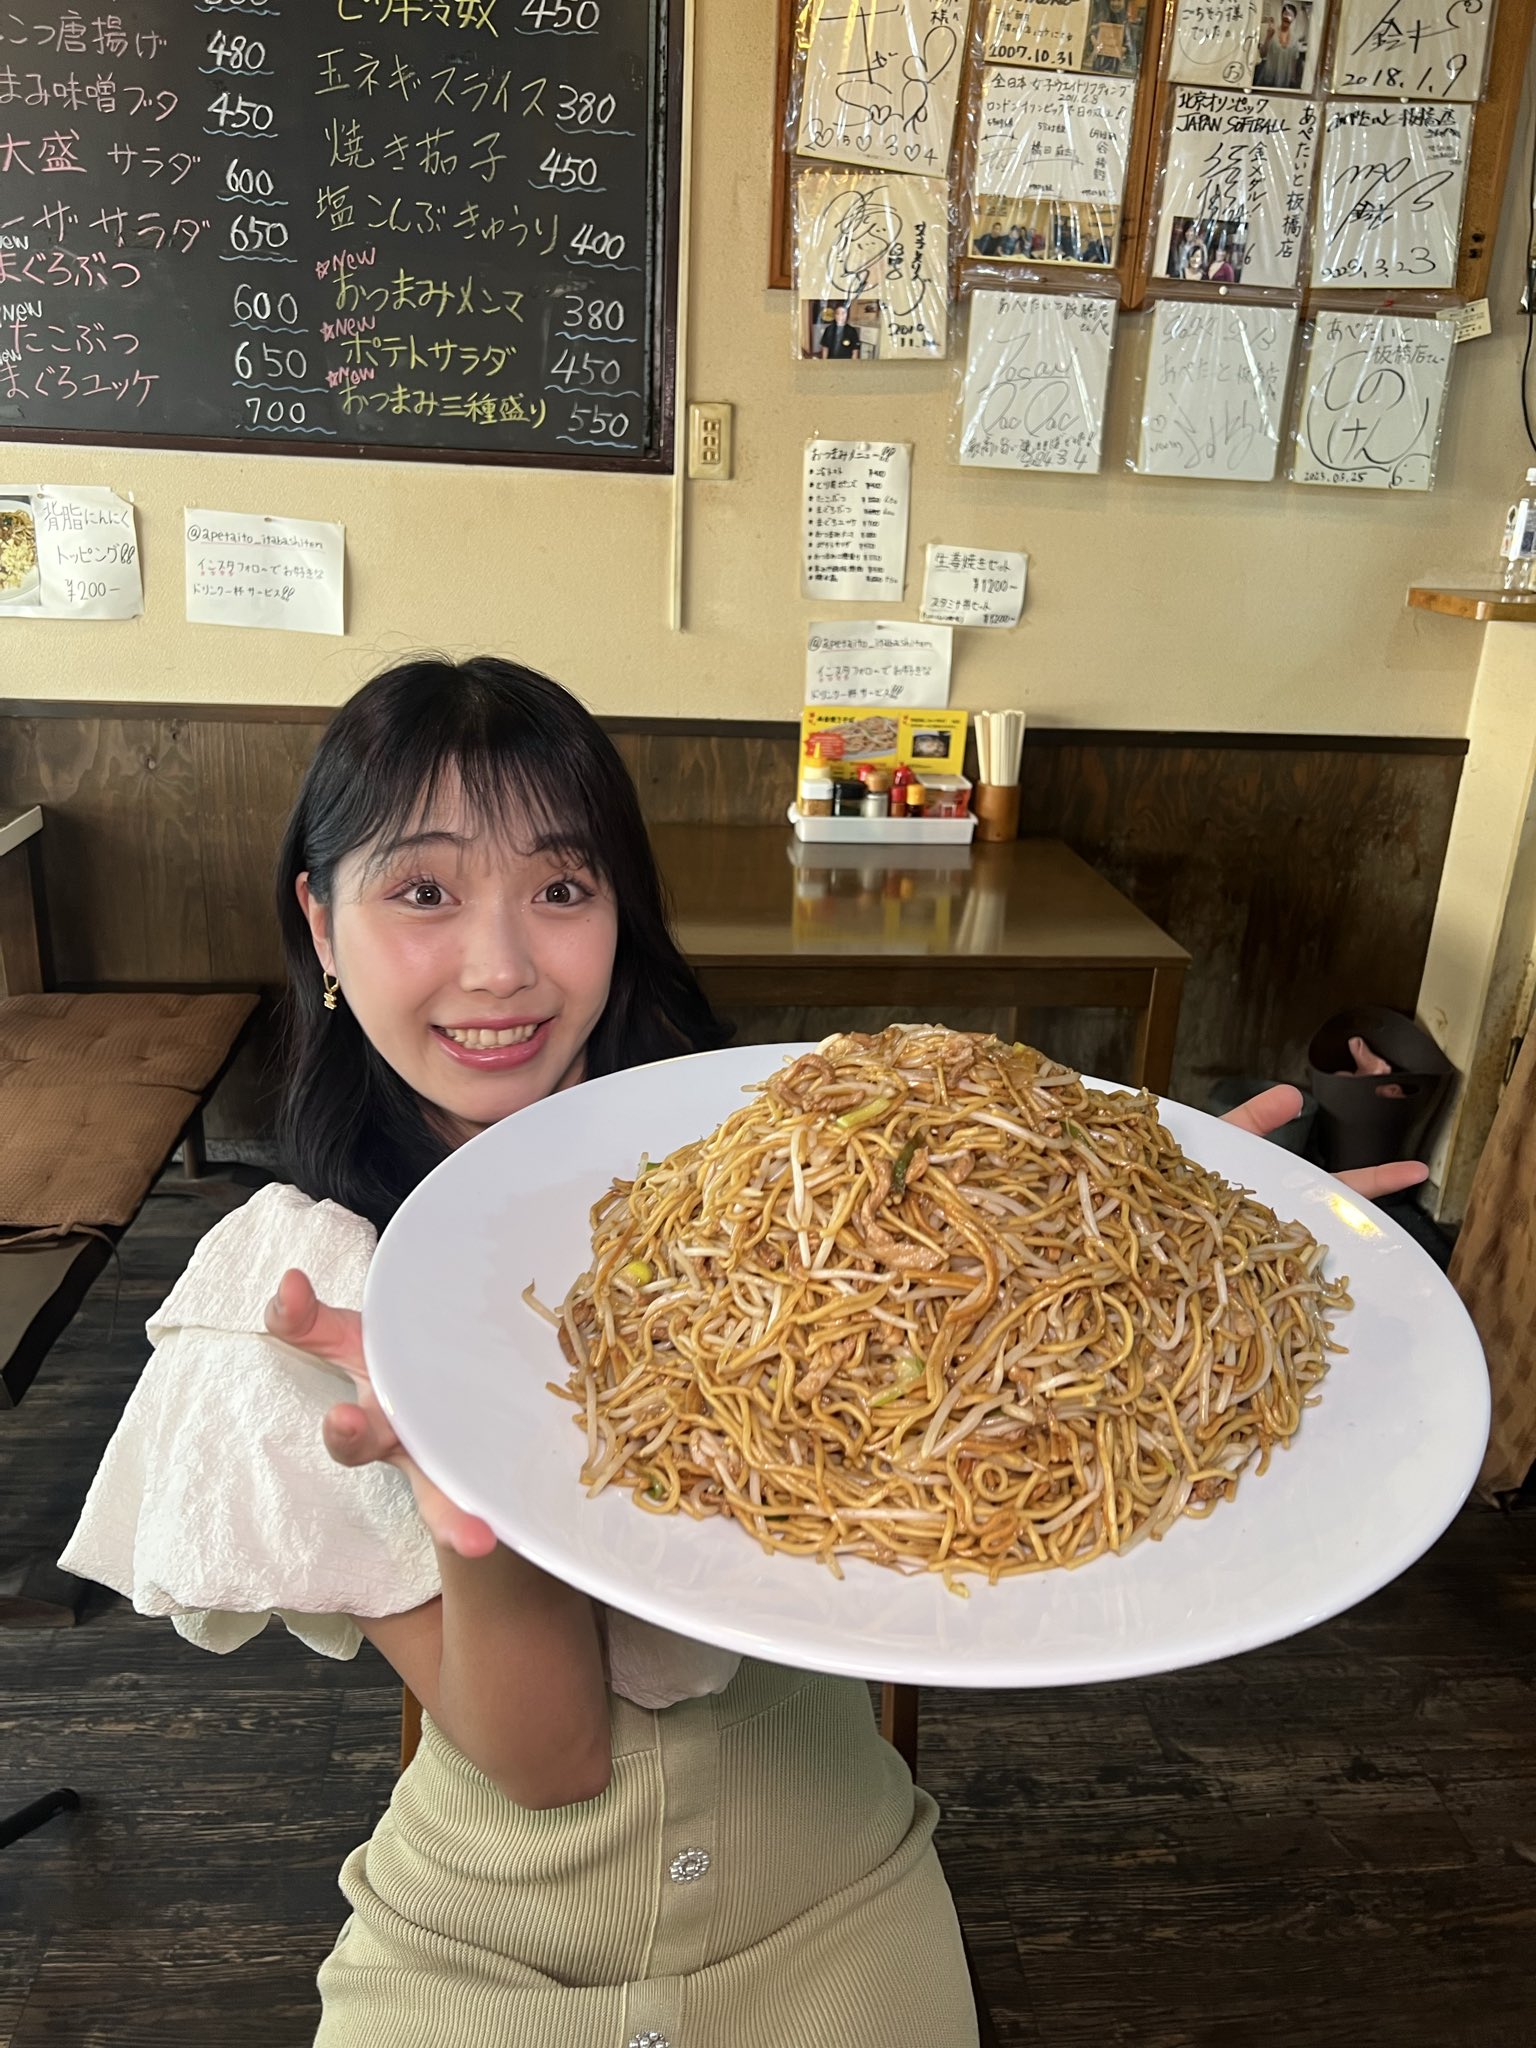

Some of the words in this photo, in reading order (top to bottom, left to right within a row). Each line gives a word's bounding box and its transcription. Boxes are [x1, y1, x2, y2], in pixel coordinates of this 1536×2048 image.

[0, 10, 167, 59] こつ唐揚げ
[207, 30, 266, 69] 480
[521, 0, 600, 29] 450
[207, 92, 273, 130] 450
[315, 49, 547, 116] 玉ネギスライス
[557, 85, 616, 124] 380
[1178, 91, 1269, 113] 北京オリンピック
[1176, 115, 1223, 132] JAPAN
[1223, 115, 1290, 135] SOFTBALL
[226, 158, 274, 195] 600
[325, 118, 507, 182] 焼き茄子
[539, 148, 597, 187] 450
[1275, 103, 1317, 258] あぺたいと板橋店
[0, 235, 29, 250] ew
[230, 215, 289, 251] 650
[316, 186, 558, 256] 塩こんぶきゅうり
[571, 223, 626, 260] 400
[234, 284, 298, 324] 600
[332, 250, 524, 323] おつまみメンマ
[563, 295, 625, 331] 380
[10, 319, 139, 354] たこぶつ
[235, 341, 307, 379] 650
[341, 331, 517, 376] ポテトサラダ
[551, 349, 621, 385] 450
[0, 360, 160, 407] まぐろユッケ
[246, 398, 306, 424] 700
[339, 374, 547, 428] おつまみ三種盛り
[568, 402, 629, 438] 550
[43, 500, 130, 531] 背脂にんにく
